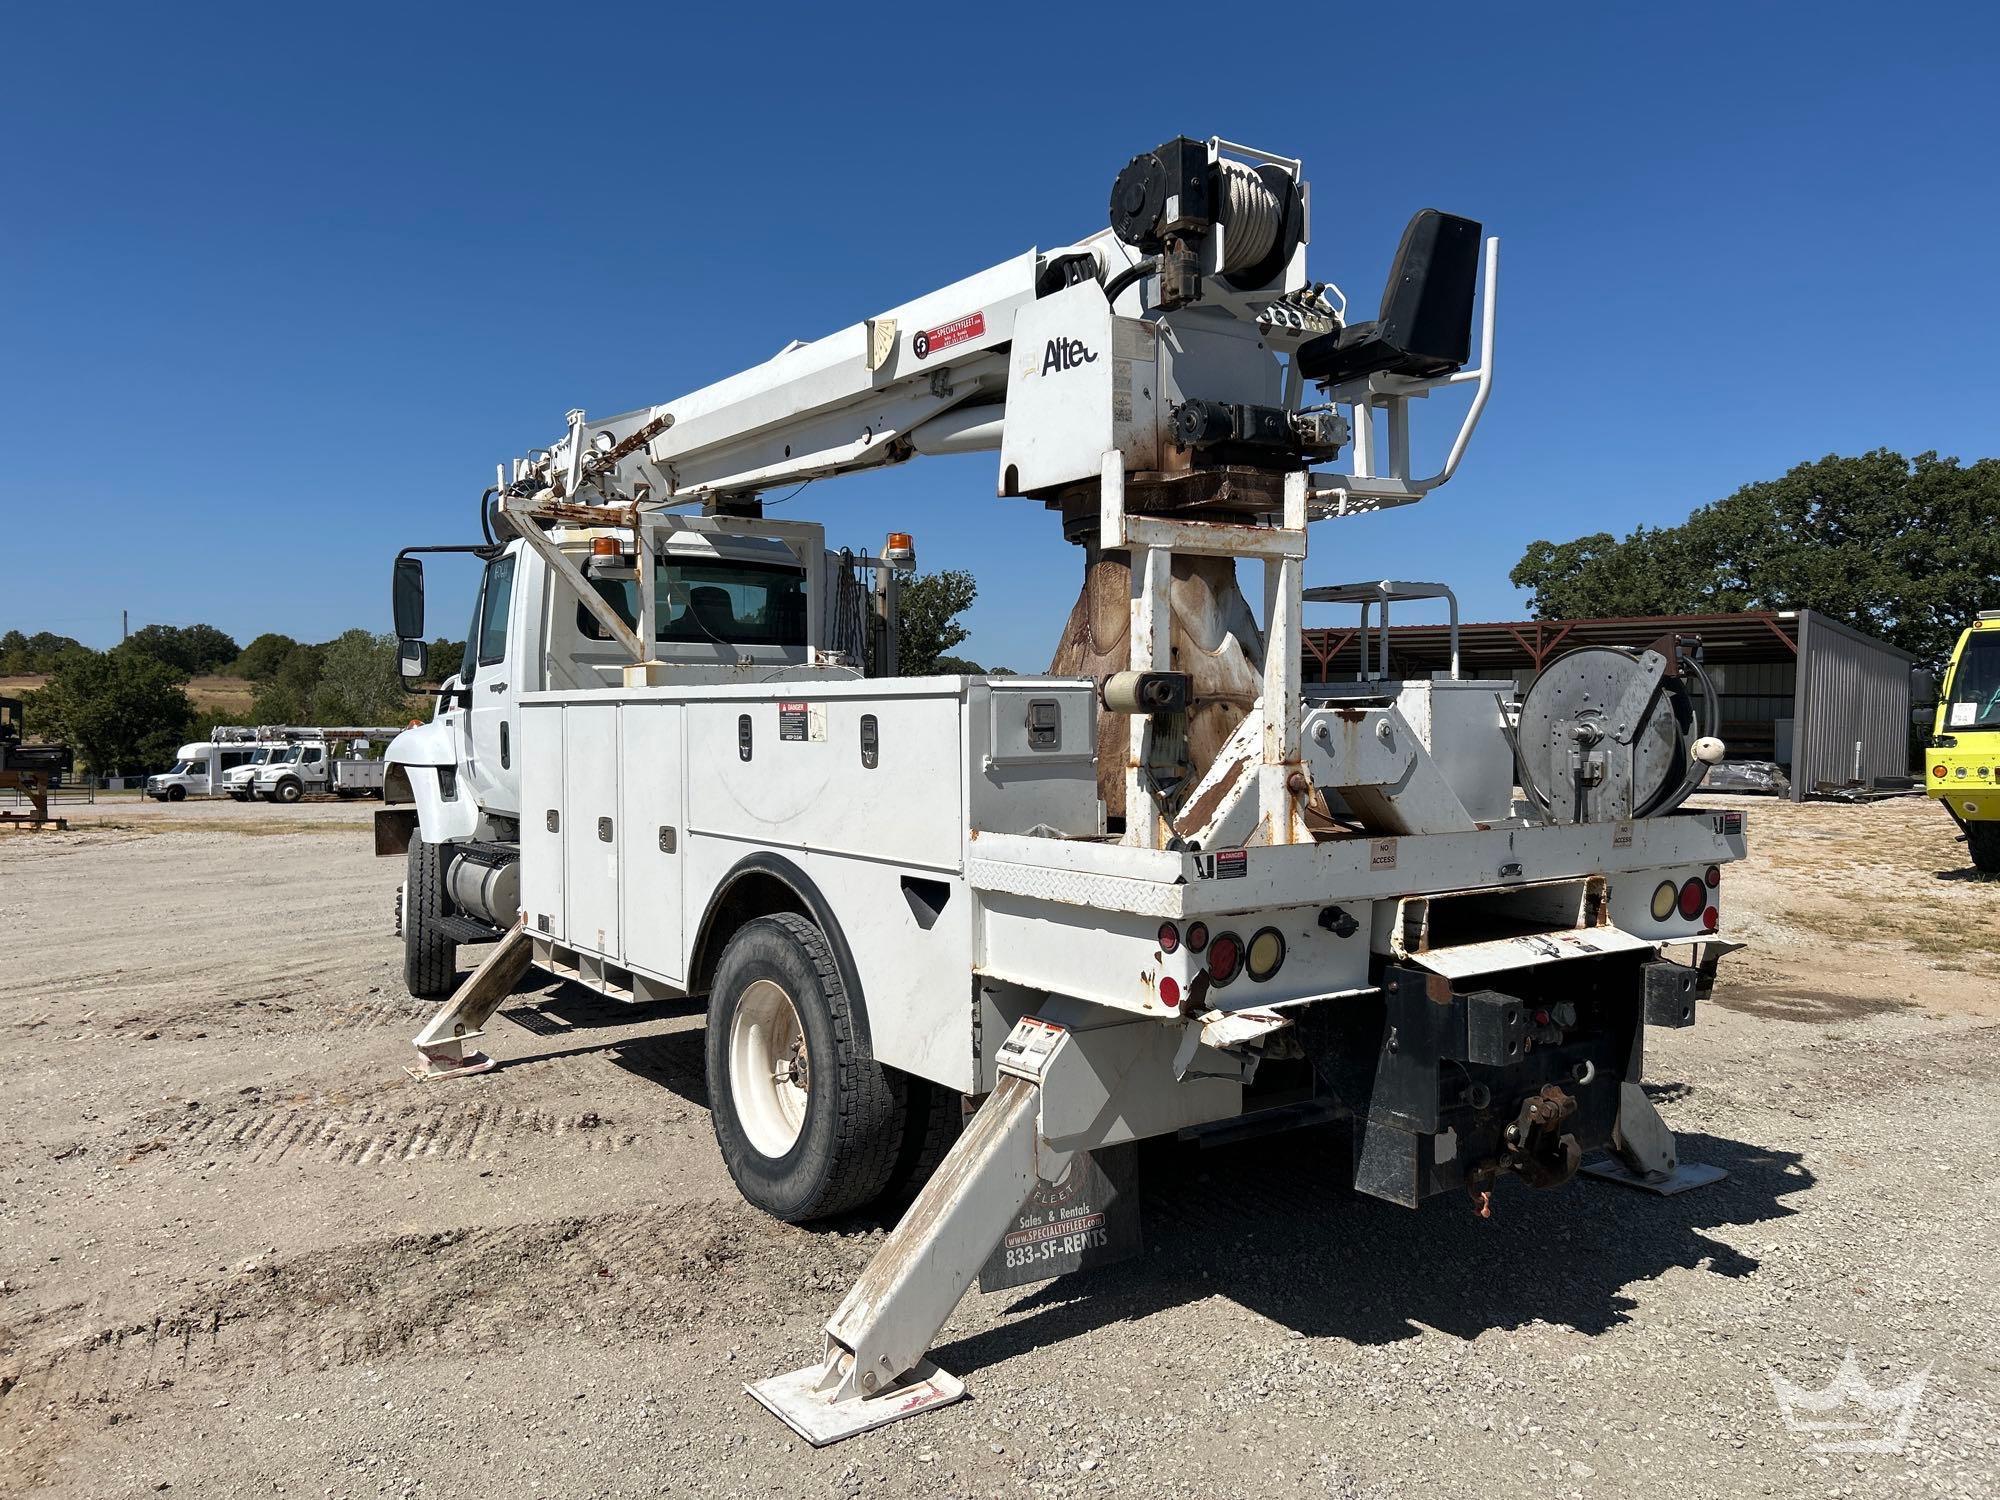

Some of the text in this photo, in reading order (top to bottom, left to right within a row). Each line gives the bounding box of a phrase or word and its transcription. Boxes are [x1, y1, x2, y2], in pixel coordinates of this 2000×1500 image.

[1042, 336, 1098, 377] Altec
[787, 703, 804, 711] DANGER
[1226, 851, 1244, 859] DANGER
[1380, 844, 1389, 852] NO
[1372, 855, 1395, 865] ACCESS
[1033, 1184, 1073, 1204] FLEET
[1019, 1202, 1090, 1229] Sales & Rentals
[1008, 1217, 1102, 1246] www.SPECIALTYFLEET.com
[1006, 1228, 1107, 1268] 833-SF-RENTS
